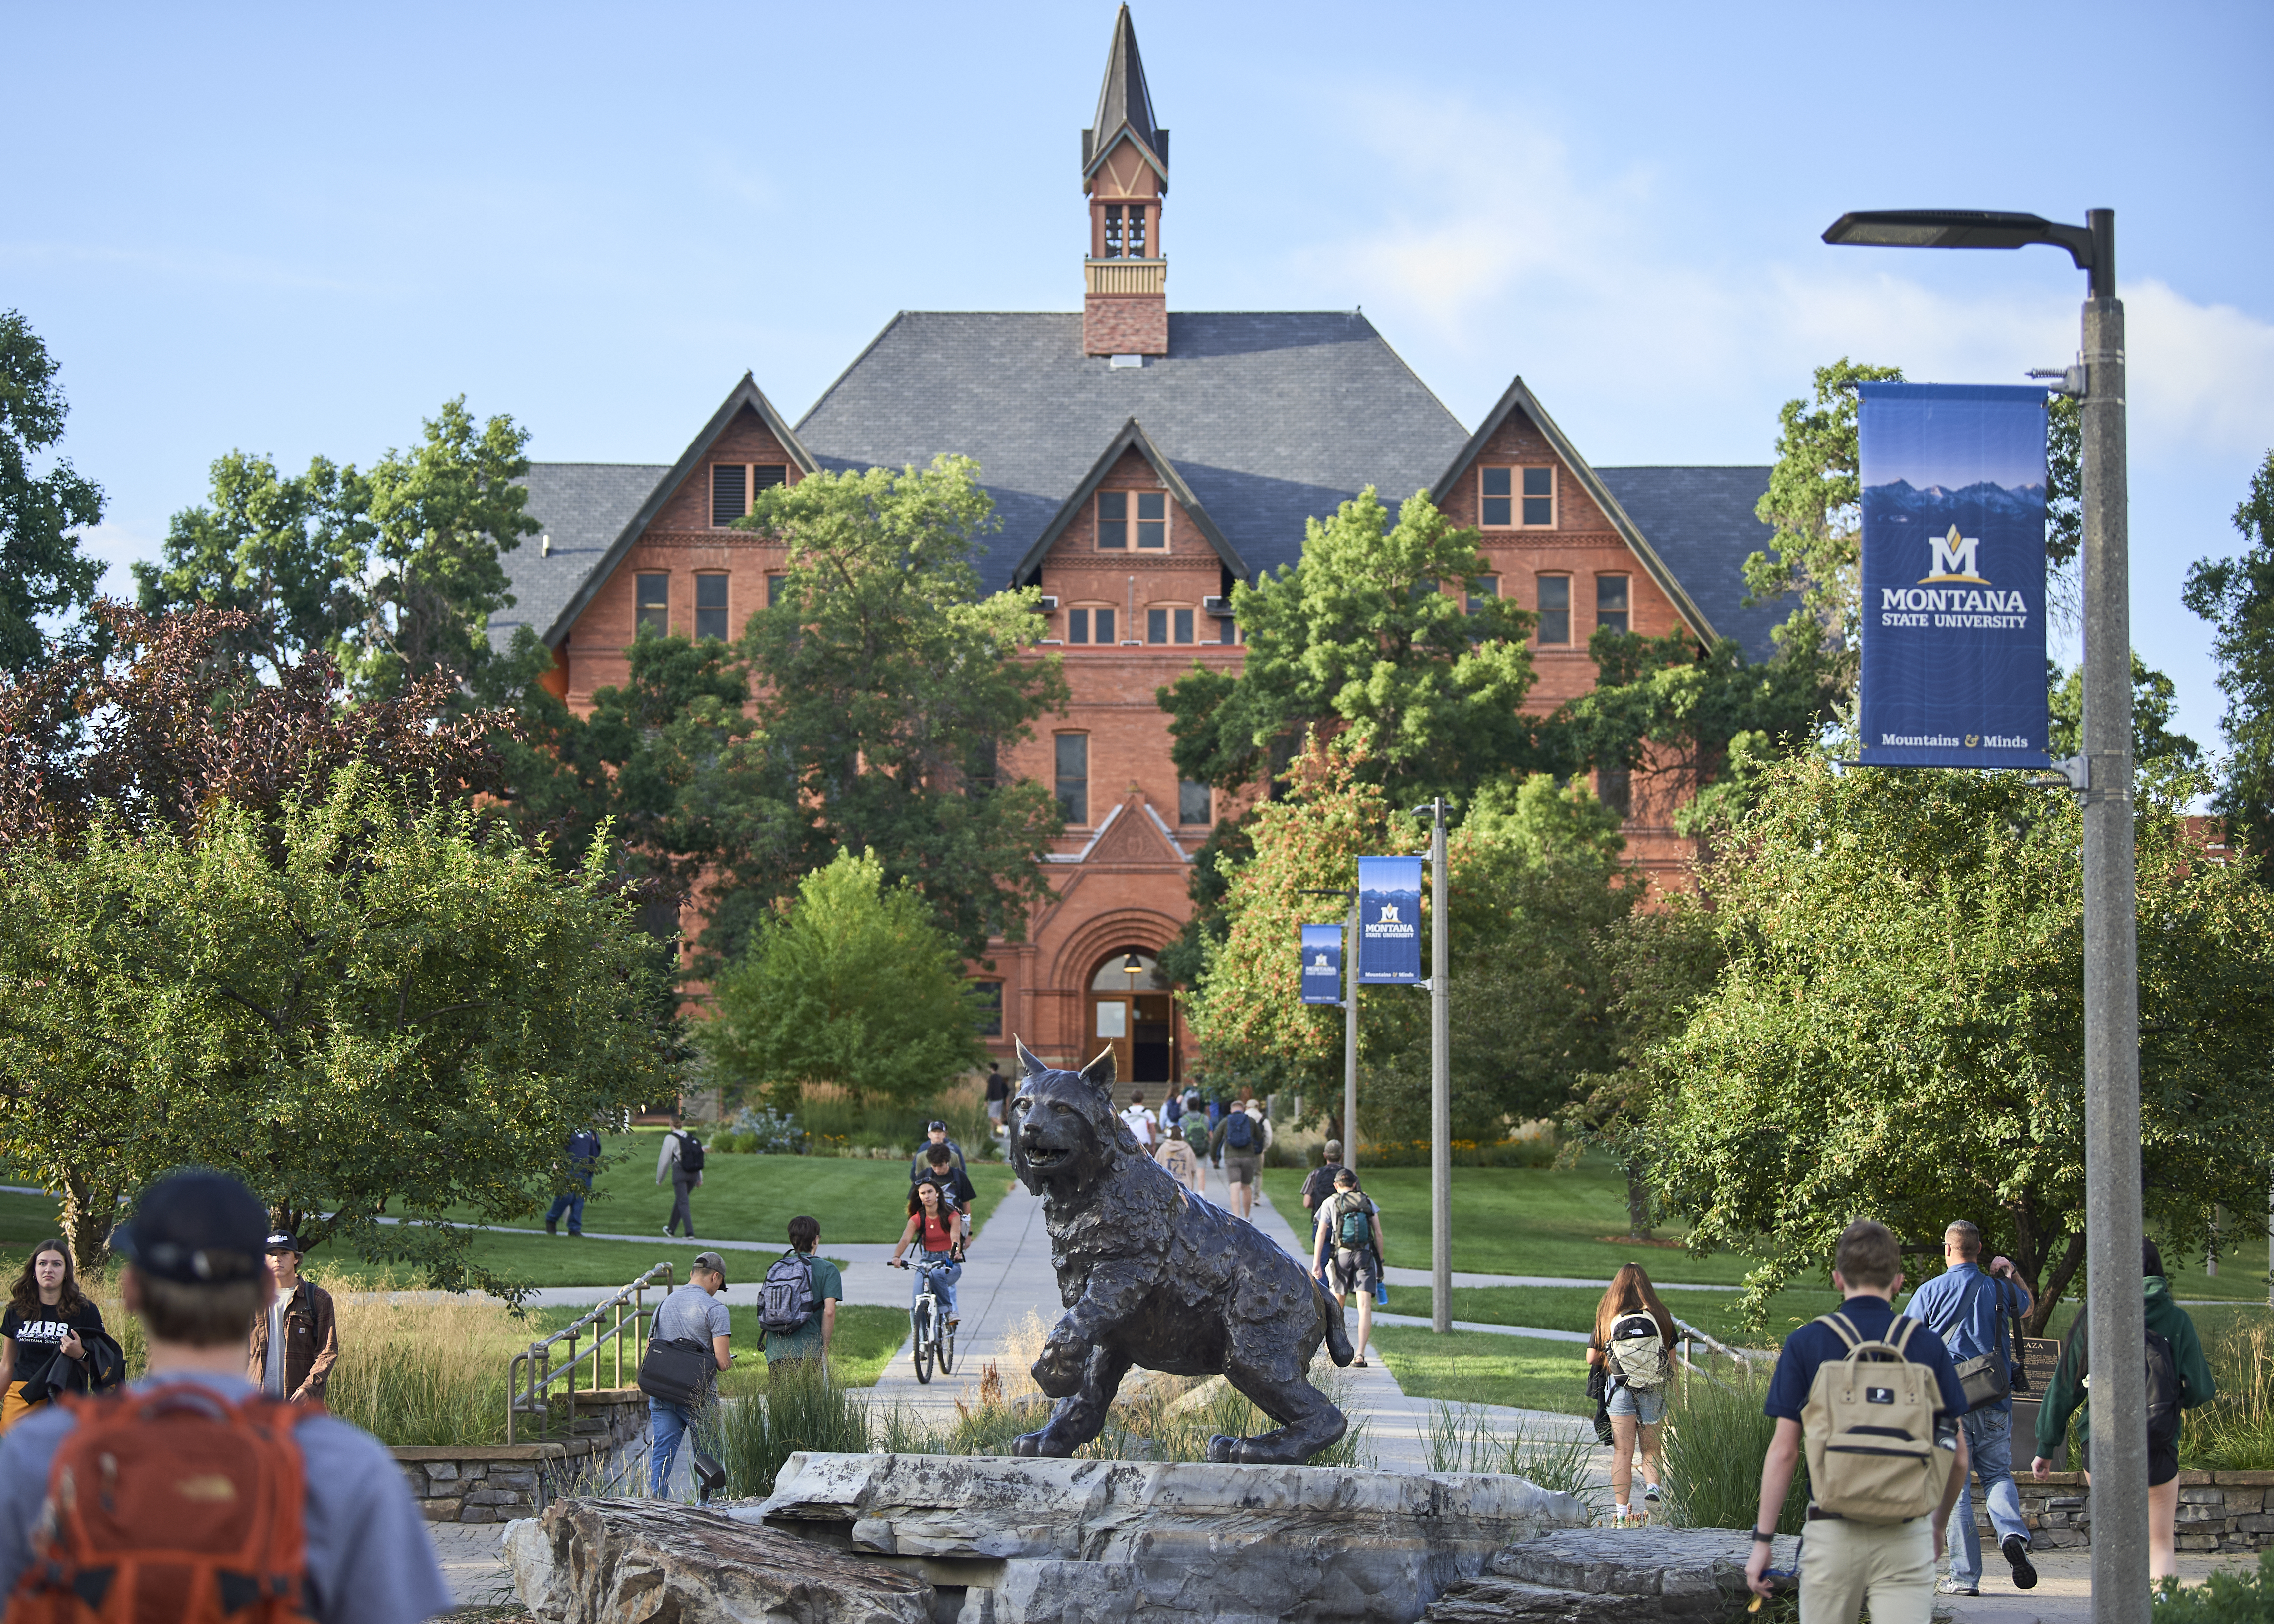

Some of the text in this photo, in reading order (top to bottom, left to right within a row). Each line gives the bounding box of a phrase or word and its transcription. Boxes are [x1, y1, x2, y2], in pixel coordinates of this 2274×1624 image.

[1881, 588, 2027, 612] MONTANA
[1882, 613, 2027, 628] STATE UNIVERSITY
[1882, 733, 2028, 748] Mountains & Minds
[18, 1320, 69, 1337] JABS
